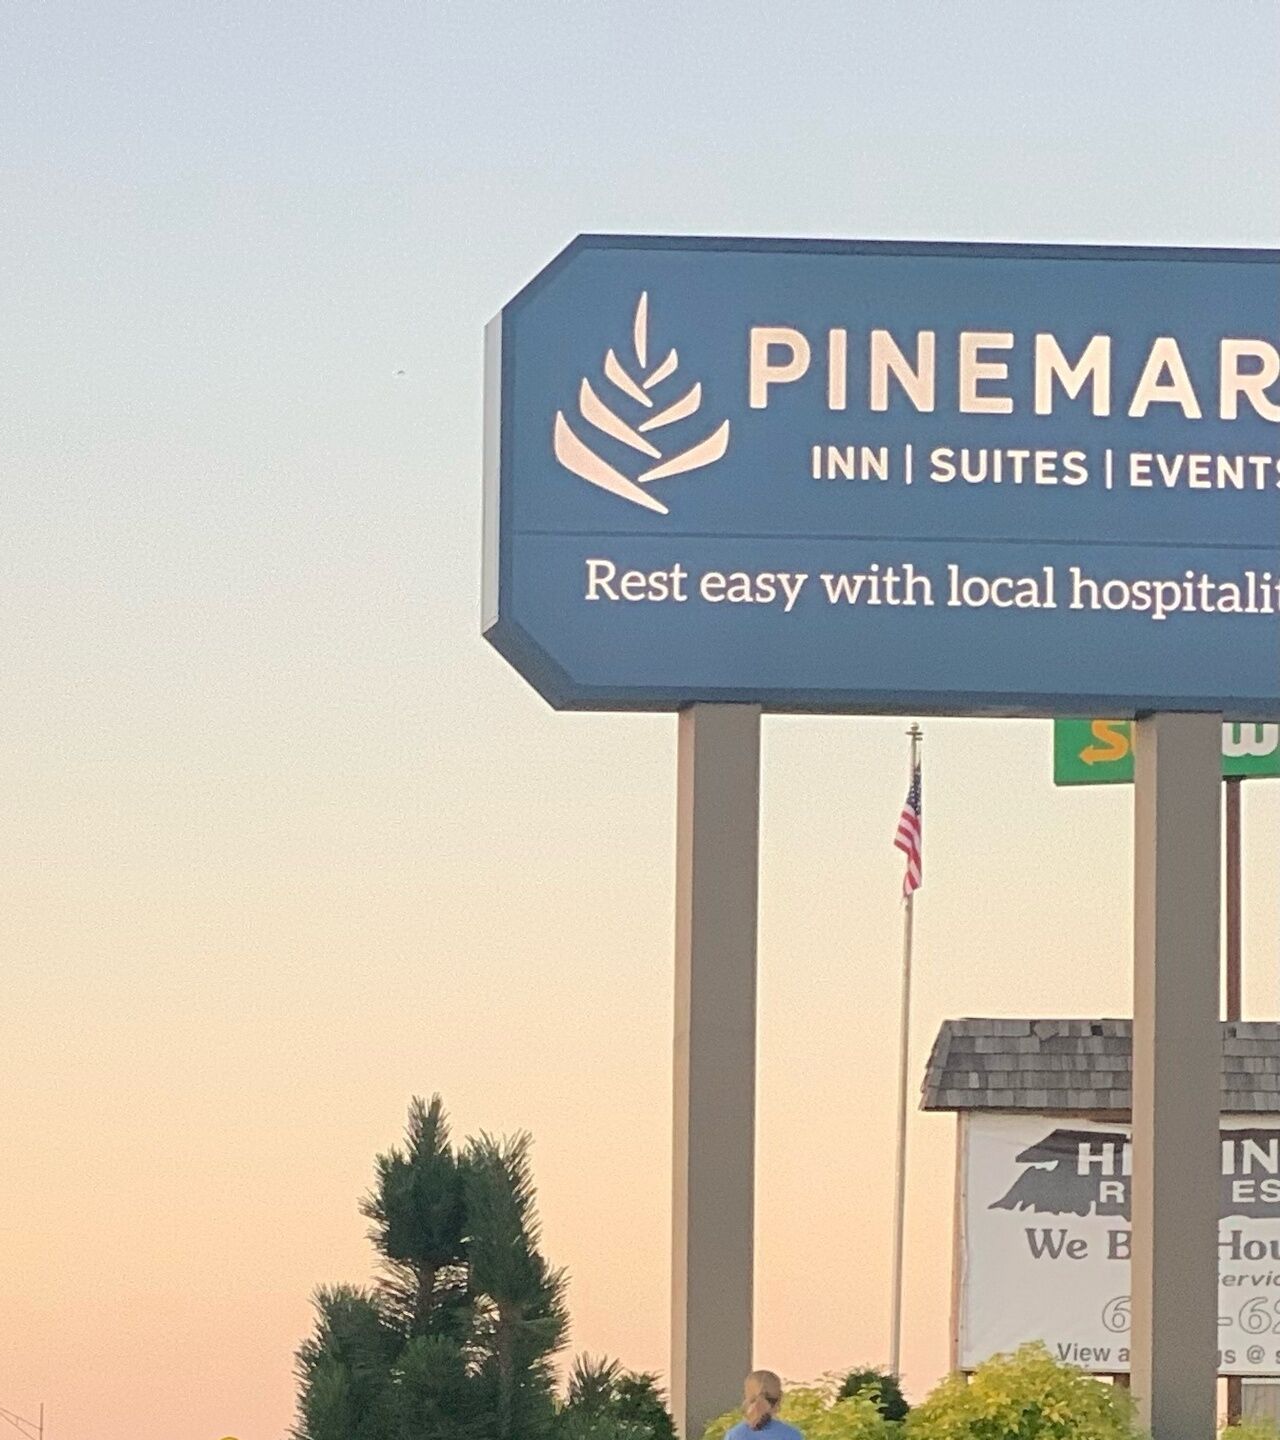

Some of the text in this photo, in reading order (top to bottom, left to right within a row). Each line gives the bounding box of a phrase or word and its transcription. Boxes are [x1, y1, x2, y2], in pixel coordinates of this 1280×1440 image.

[812, 445, 889, 481] INN
[930, 447, 1089, 486] SUITES
[584, 559, 688, 602] Rest
[699, 571, 809, 612] easy
[819, 563, 935, 607] with
[947, 564, 1057, 609] local
[1024, 1227, 1089, 1260] We
[1057, 1342, 1110, 1362] View
